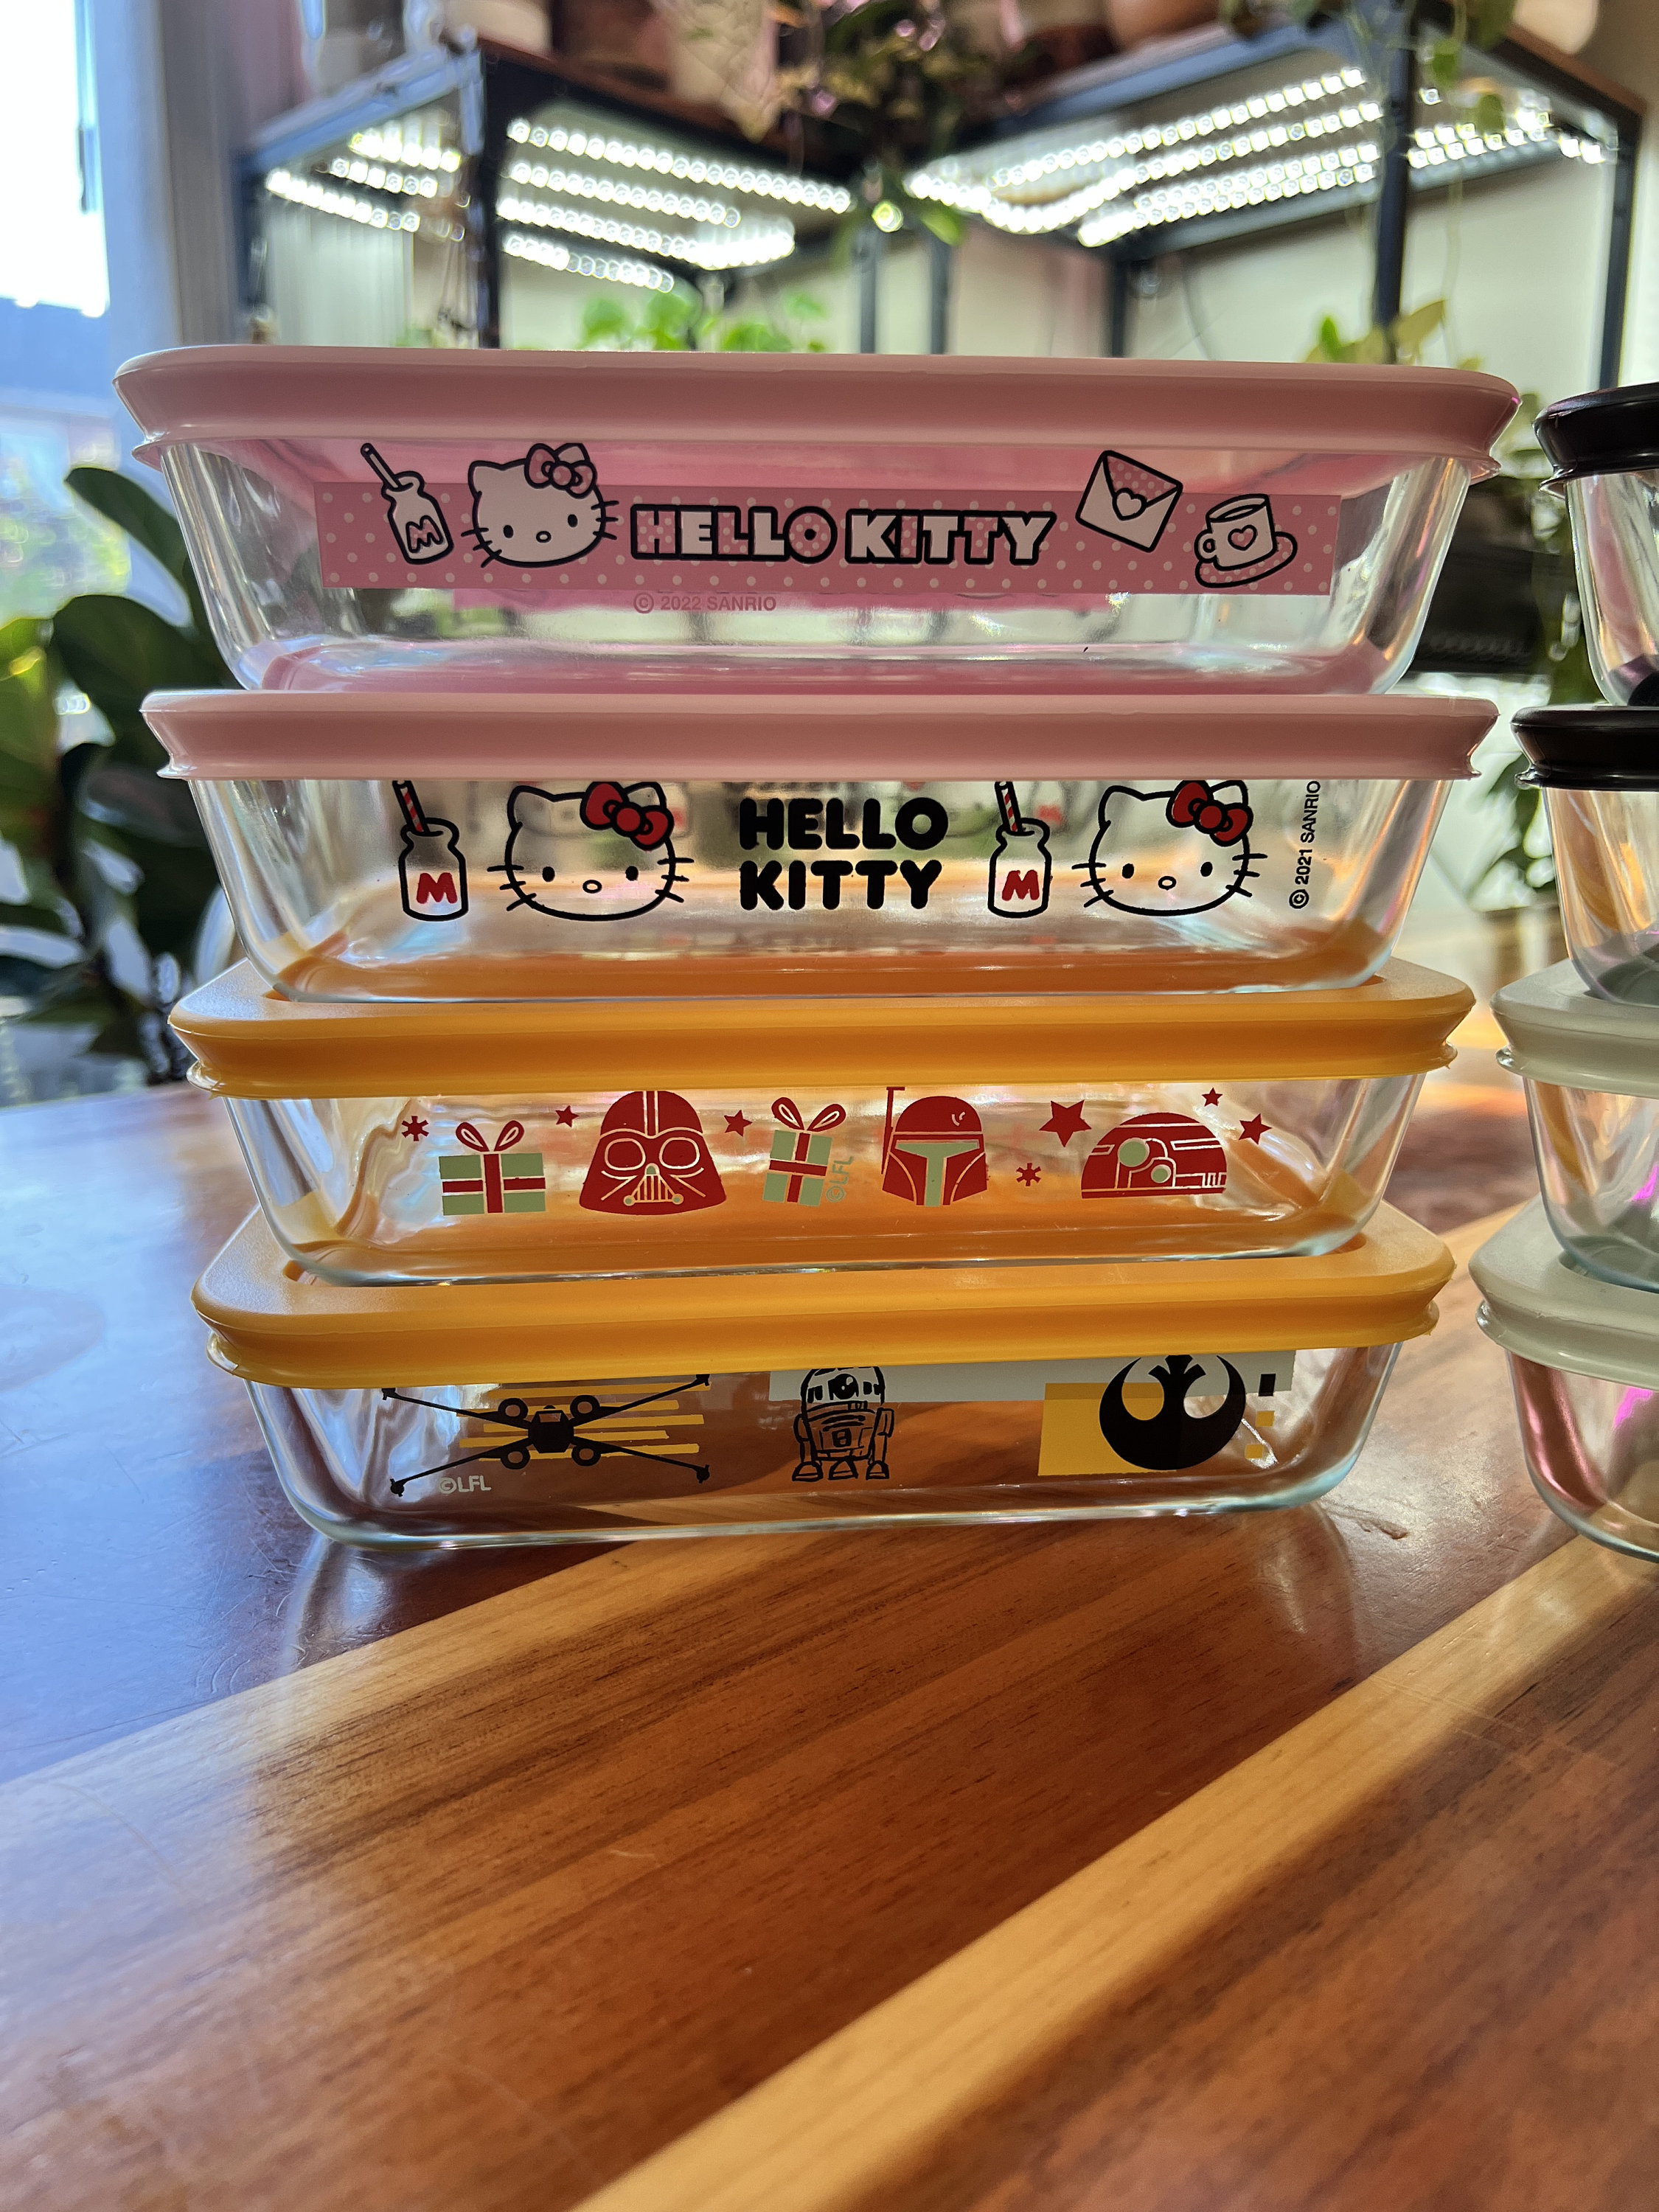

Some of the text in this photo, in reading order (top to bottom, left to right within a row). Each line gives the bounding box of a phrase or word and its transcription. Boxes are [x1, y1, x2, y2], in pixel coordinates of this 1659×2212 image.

[406, 515, 442, 554] M
[630, 504, 1057, 565] HELLO KITTY
[661, 596, 702, 611] 2022
[706, 596, 776, 612] SANRIO
[739, 797, 948, 850] HELLO
[1300, 780, 1321, 844] SANRIO
[739, 859, 943, 911] KITTY
[1001, 869, 1040, 902] M
[1295, 846, 1313, 886] 2021
[416, 872, 457, 904] M
